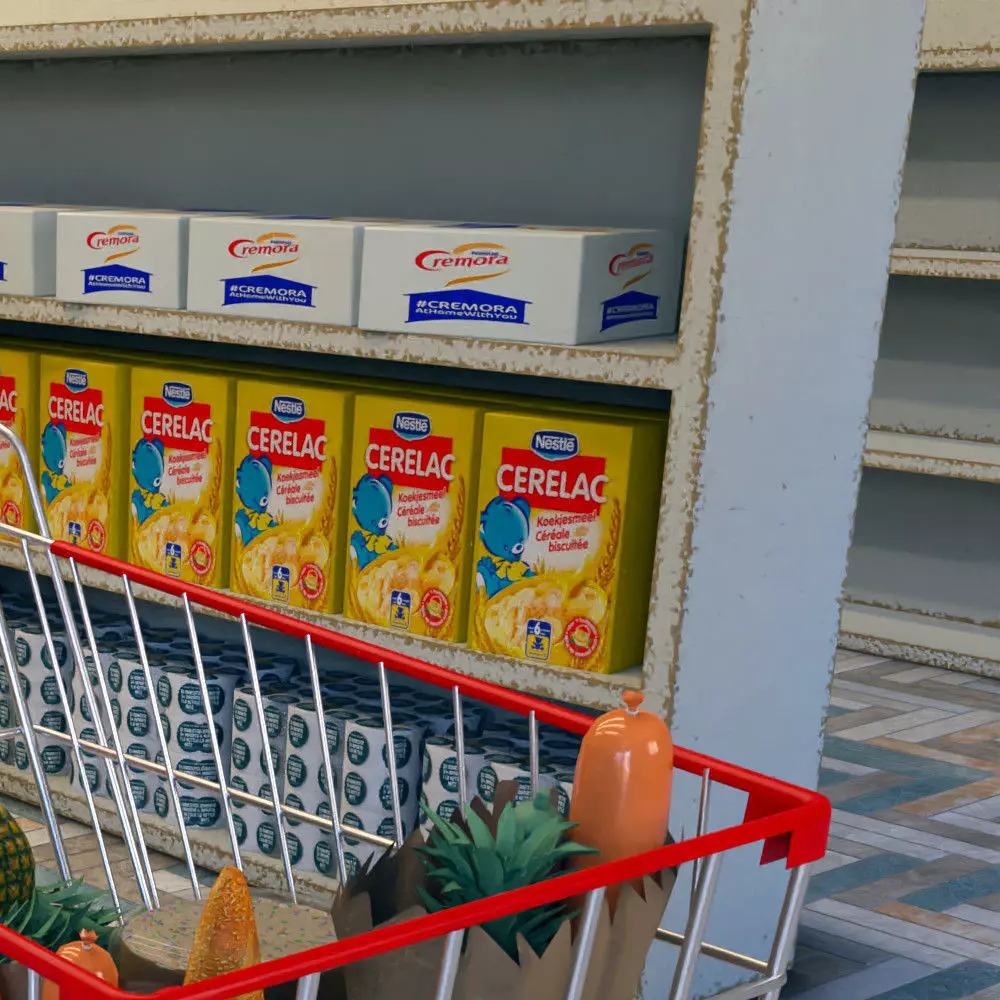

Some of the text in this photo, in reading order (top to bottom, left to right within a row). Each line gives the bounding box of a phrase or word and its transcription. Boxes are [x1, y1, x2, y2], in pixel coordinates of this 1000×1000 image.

[86, 231, 140, 250] Cremora
[228, 239, 300, 259] Cremora
[415, 249, 510, 272] Cremora
[88, 274, 146, 285] #CREMORA
[230, 285, 307, 298] #CREMORA
[416, 299, 519, 314] #CREMORA
[48, 395, 105, 427] CERELAC
[141, 410, 214, 443] CERELAC
[247, 425, 328, 461] CERELAC
[365, 443, 456, 481] CERELAC
[496, 463, 610, 504] CERELAC
[534, 621, 541, 636] 6
